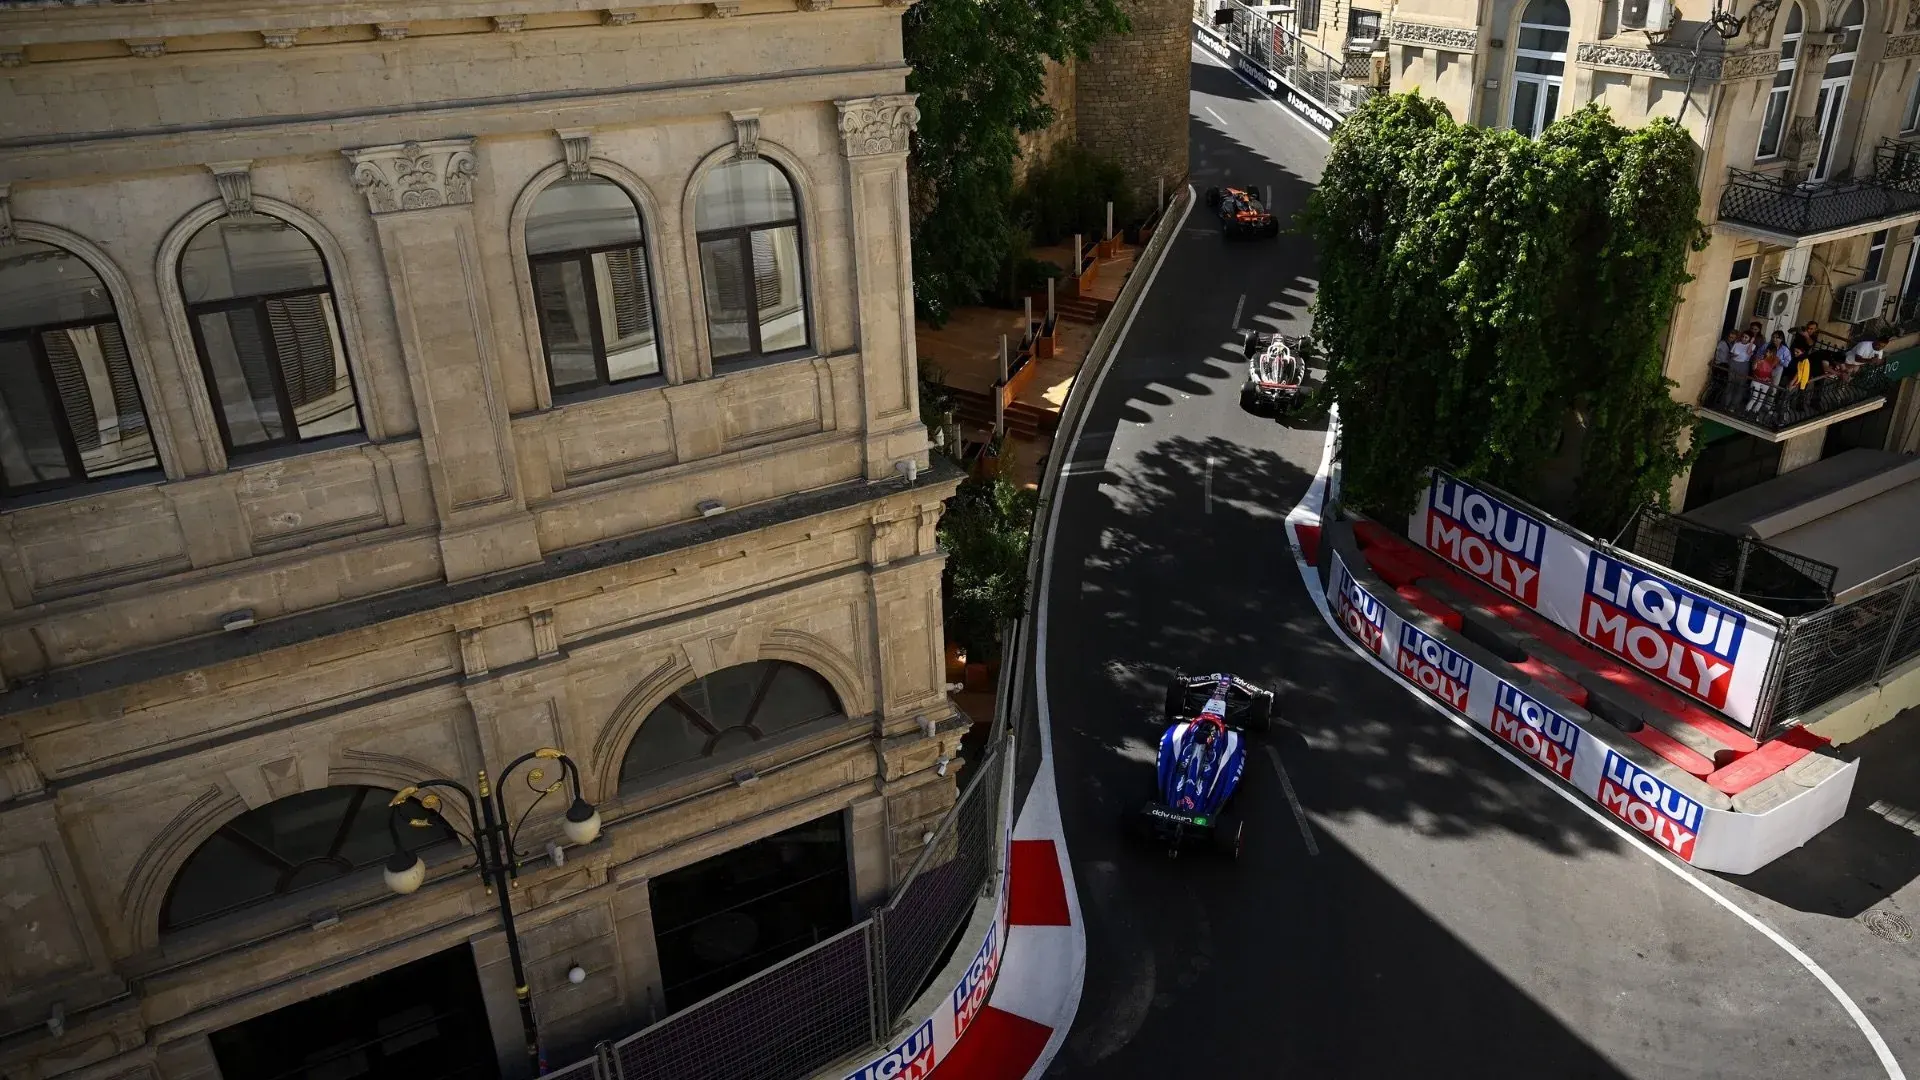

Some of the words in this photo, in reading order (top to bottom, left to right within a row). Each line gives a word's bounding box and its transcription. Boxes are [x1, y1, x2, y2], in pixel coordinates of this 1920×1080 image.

[1433, 473, 1541, 562] LIQUI
[1431, 515, 1538, 599] MOLY
[1339, 595, 1382, 649] MOLY
[1341, 569, 1384, 627] LIQUI
[1592, 558, 1740, 657] LIQUI
[1400, 652, 1467, 705] MOLY
[1403, 626, 1470, 684] LIQUI
[1586, 600, 1731, 699] MOLY
[1495, 711, 1573, 776] MOLY
[1500, 684, 1576, 750] LIQUI
[1602, 780, 1695, 855] MOLY
[1607, 754, 1699, 830] LIQUI
[957, 926, 996, 1010] LIQUI
[957, 947, 998, 1034] MOLY
[850, 1024, 930, 1080] IQUI
